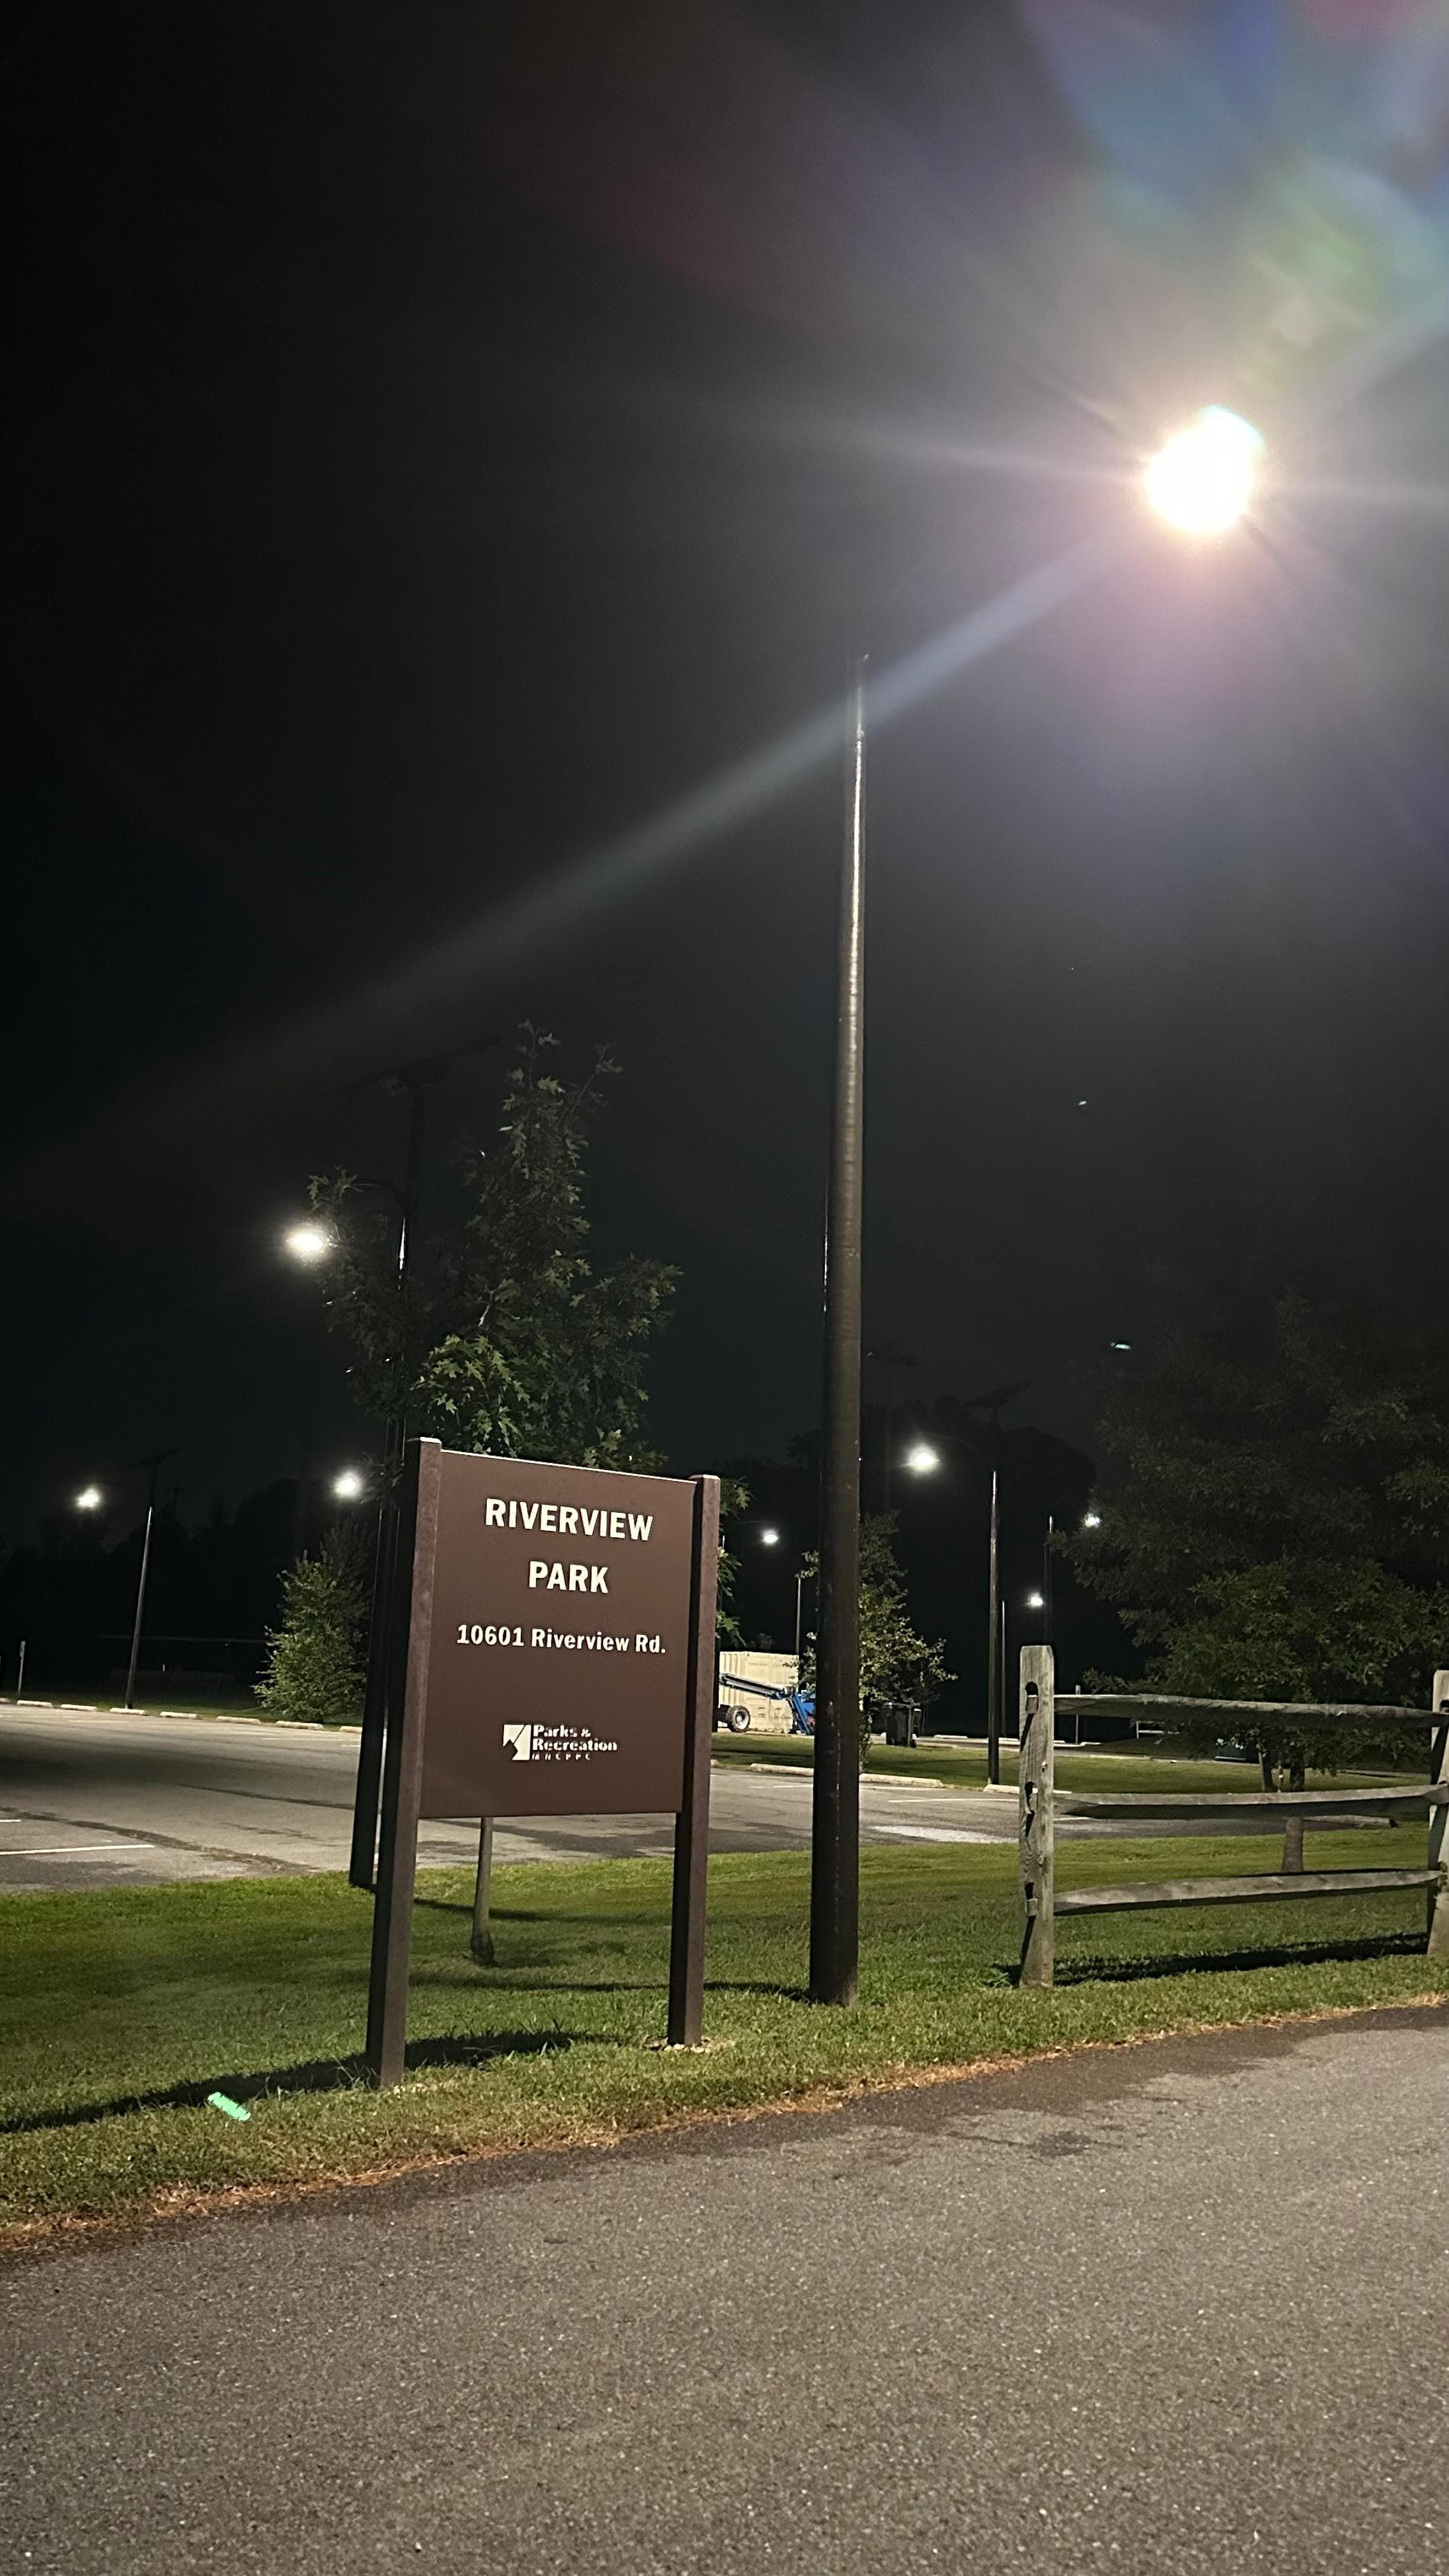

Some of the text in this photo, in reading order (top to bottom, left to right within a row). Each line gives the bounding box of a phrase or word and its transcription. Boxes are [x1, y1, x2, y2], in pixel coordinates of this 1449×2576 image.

[485, 1498, 654, 1541] RIVERVIEW
[528, 1561, 609, 1594] PARK
[457, 1624, 666, 1653] 10601 Riverview Rd.
[532, 1737, 618, 1751] Recreation
[533, 1724, 592, 1738] Parks &
